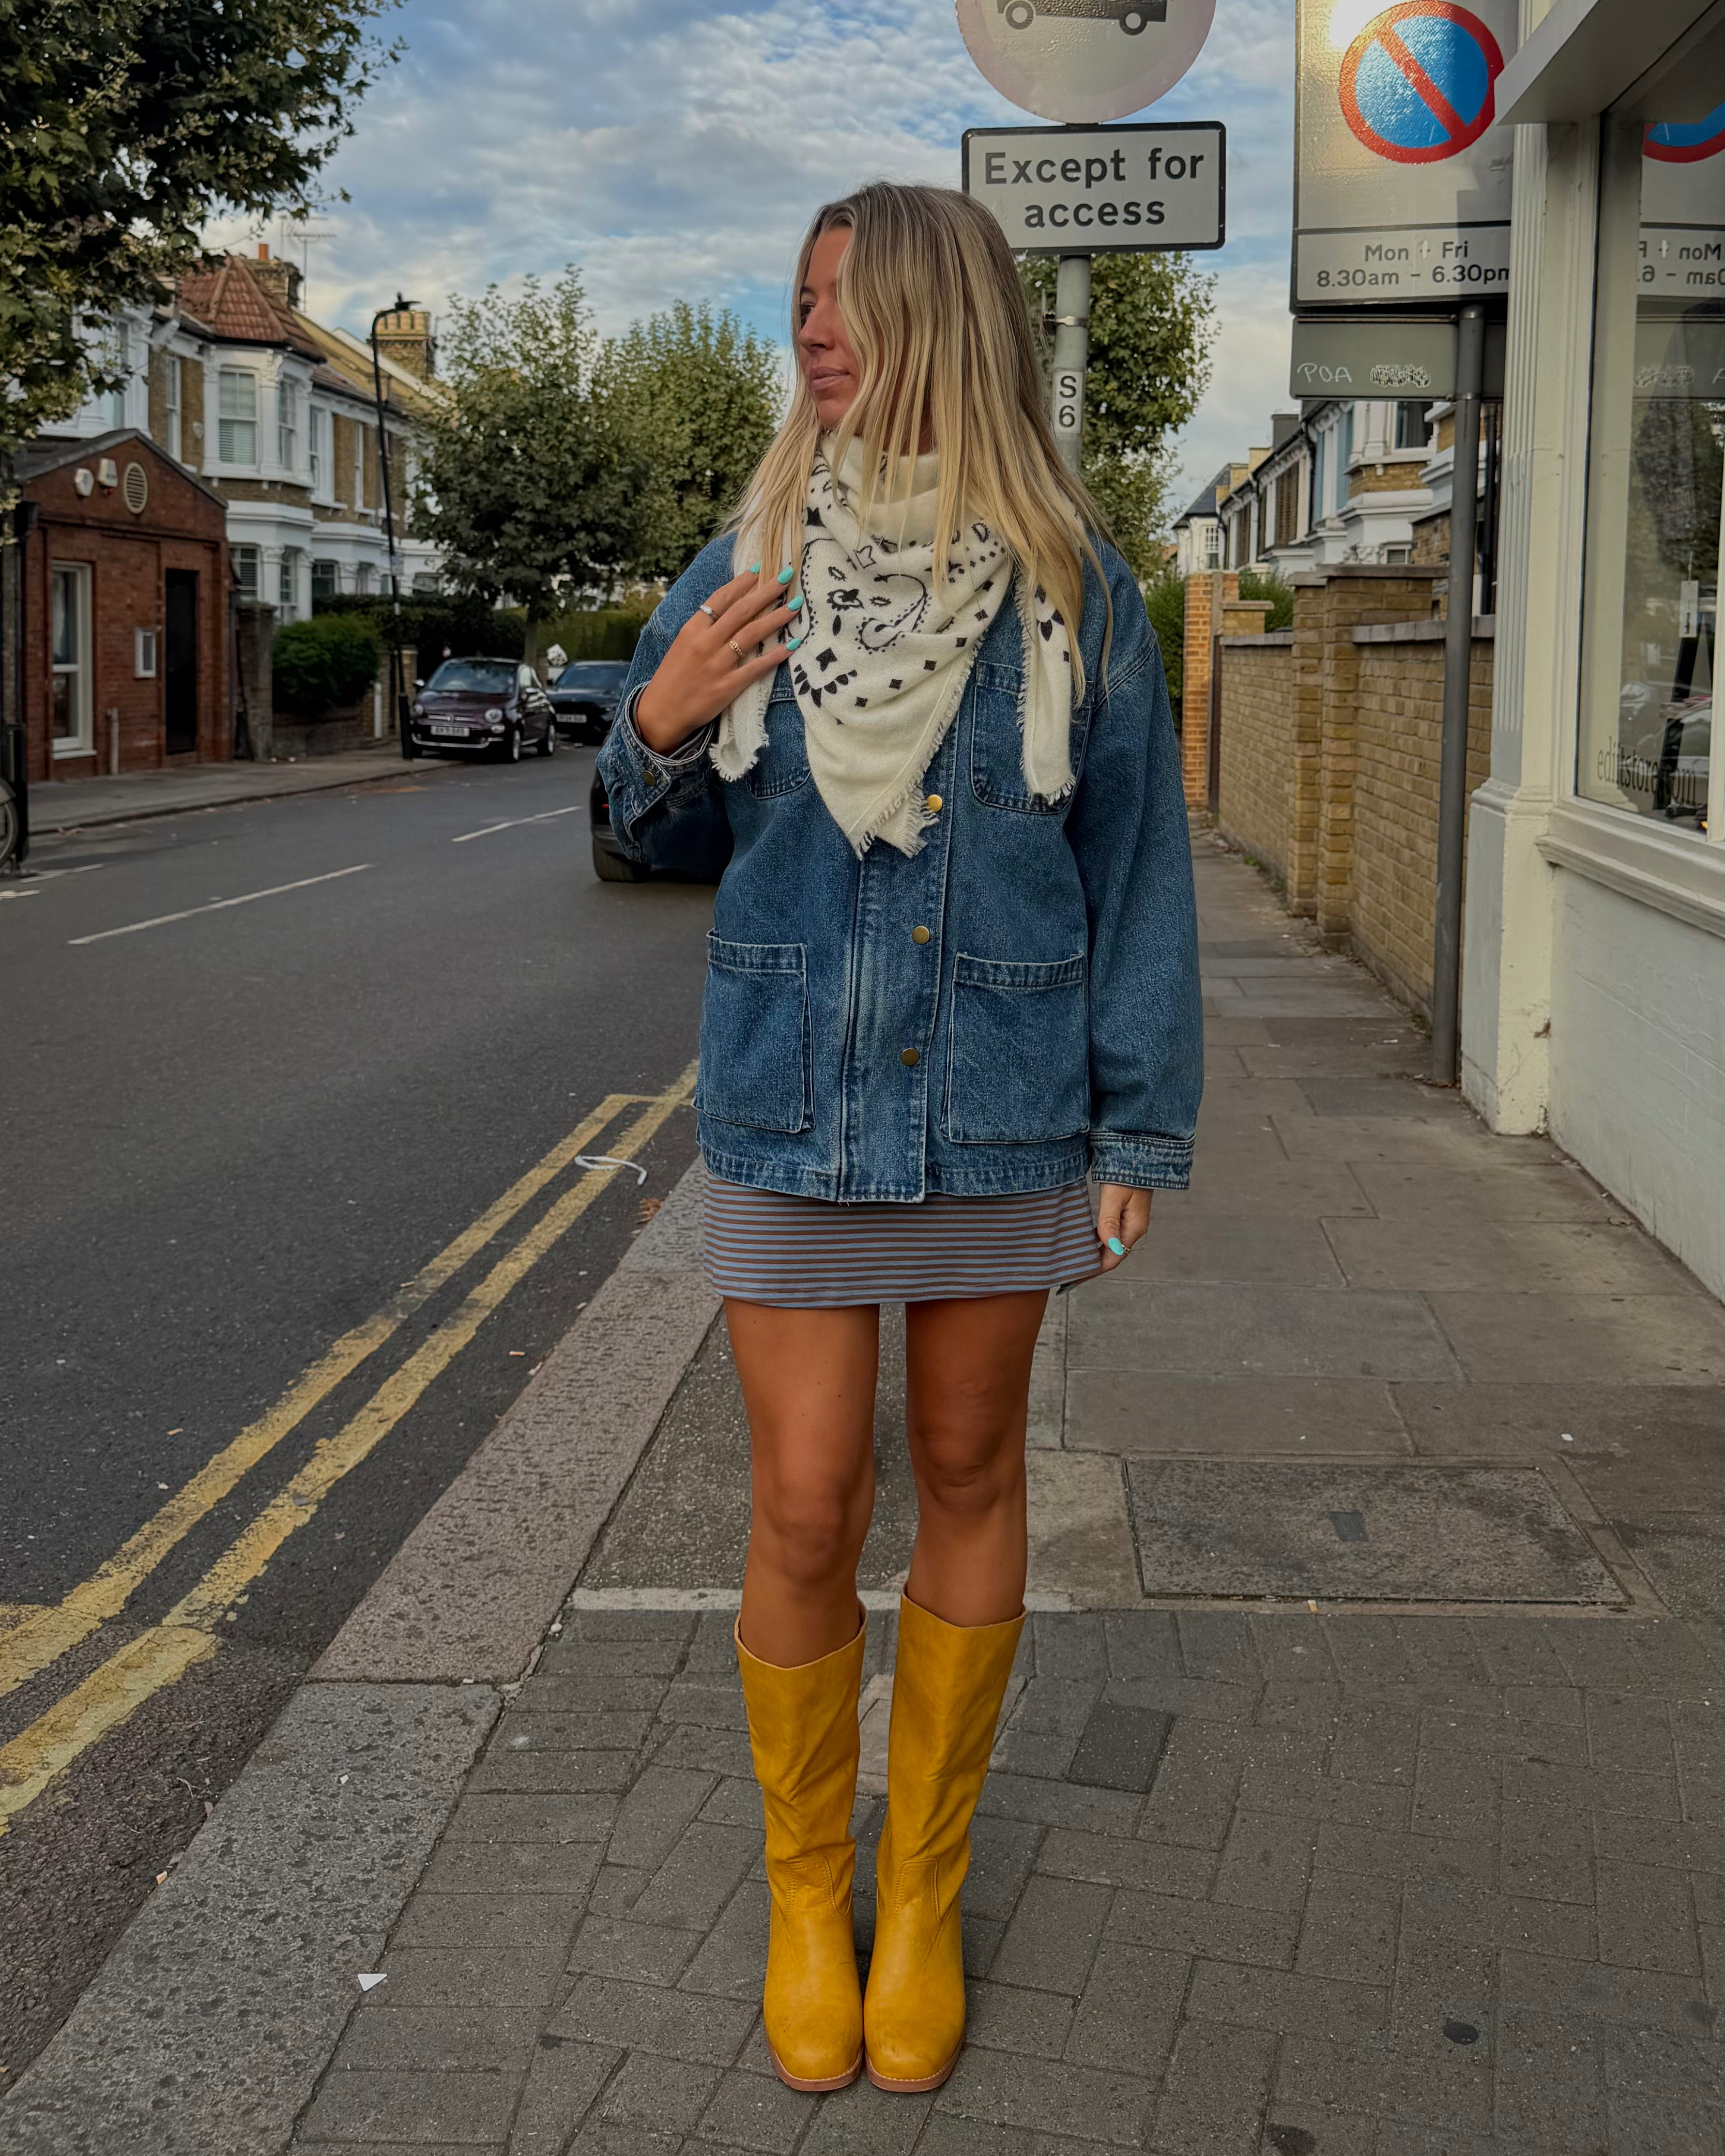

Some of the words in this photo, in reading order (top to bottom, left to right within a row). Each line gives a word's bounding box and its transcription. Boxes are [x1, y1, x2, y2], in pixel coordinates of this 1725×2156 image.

[985, 149, 1126, 189] Except
[1148, 147, 1204, 180] for
[1024, 201, 1165, 228] access
[1364, 244, 1409, 262] Mon
[1442, 241, 1468, 258] Fri
[1317, 269, 1399, 287] 8.30am
[1059, 375, 1077, 399] S
[1058, 405, 1075, 427] 6
